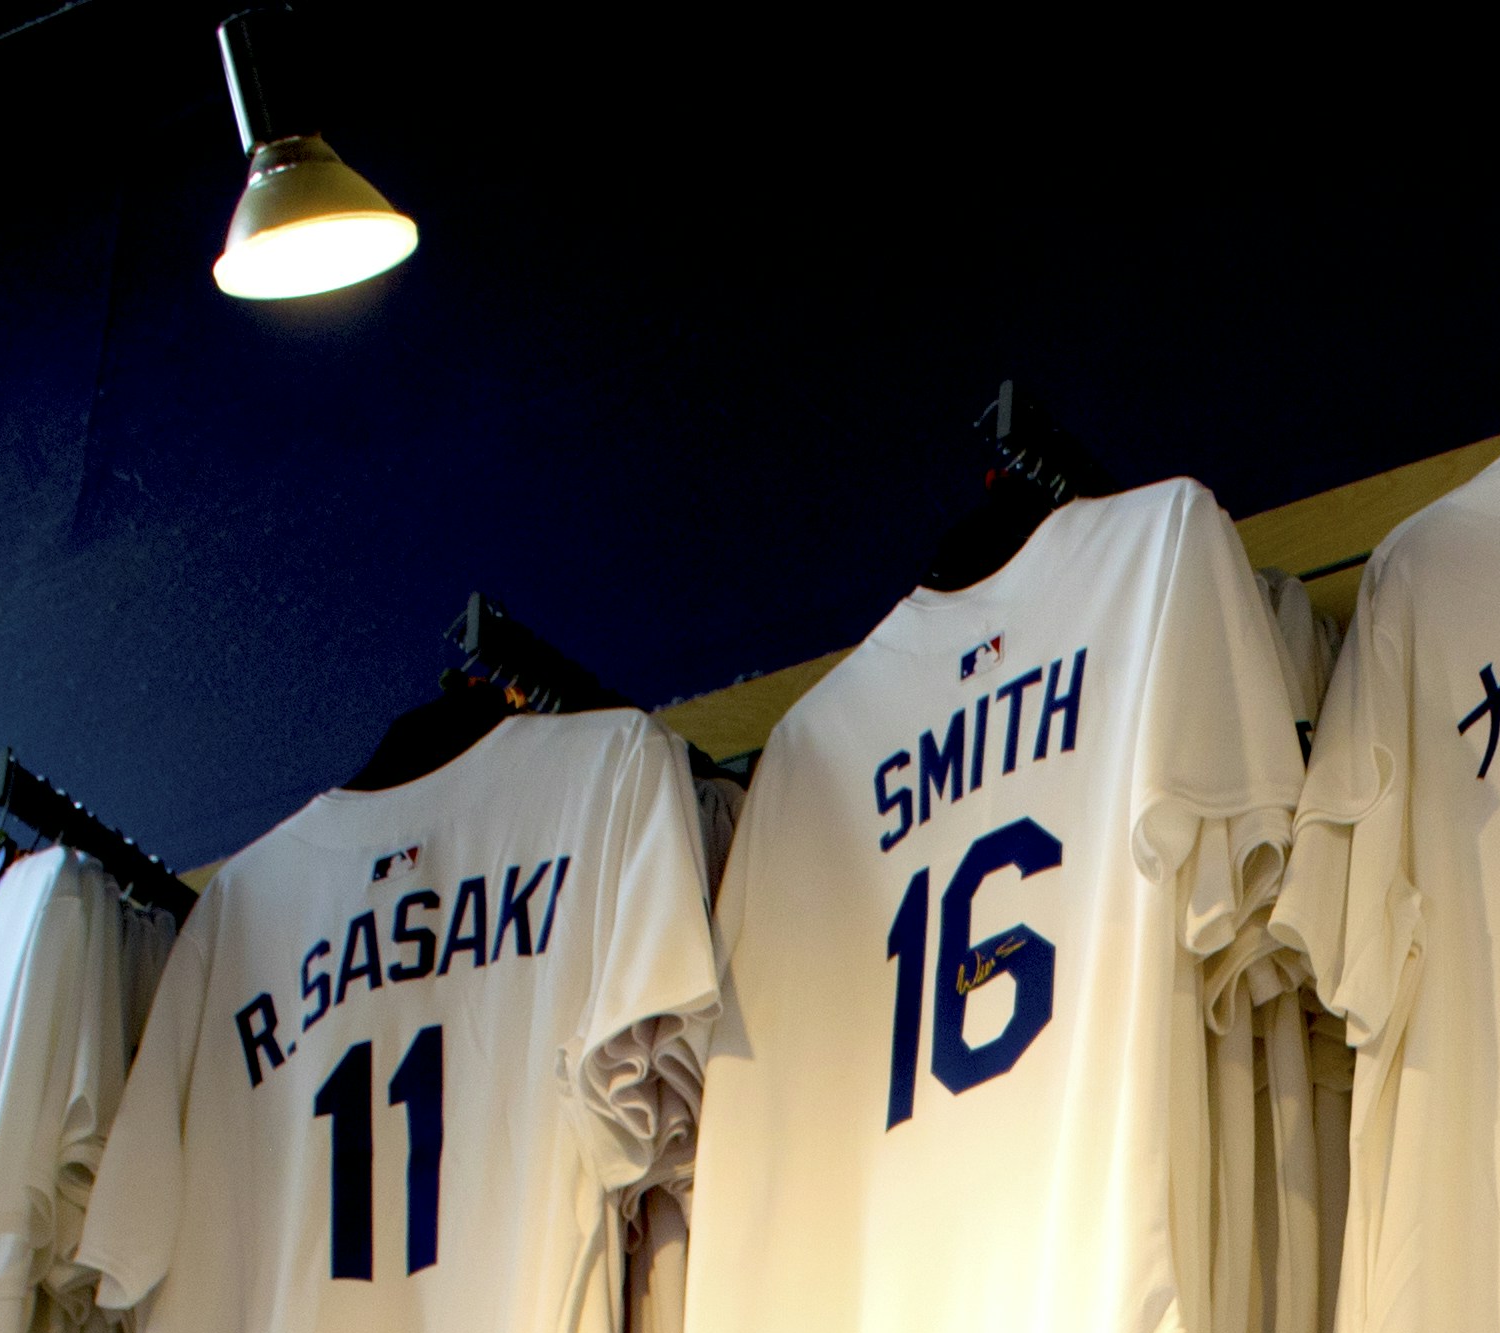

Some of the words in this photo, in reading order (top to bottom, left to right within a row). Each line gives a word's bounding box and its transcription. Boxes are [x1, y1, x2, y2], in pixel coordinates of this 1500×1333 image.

[874, 650, 1087, 853] SMITH
[886, 816, 1063, 1132] 16
[313, 1024, 444, 1283] 11
